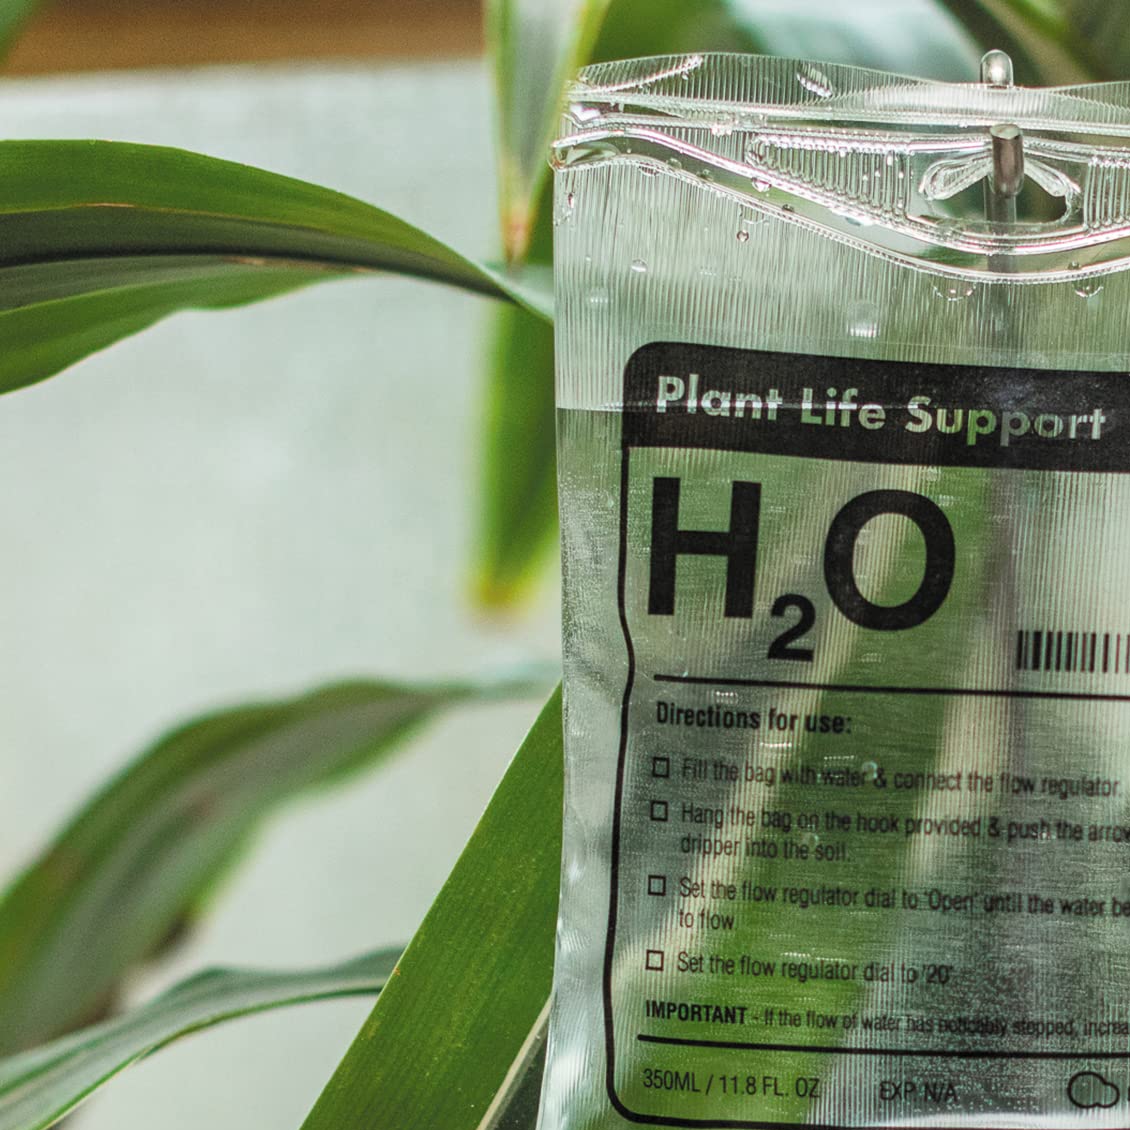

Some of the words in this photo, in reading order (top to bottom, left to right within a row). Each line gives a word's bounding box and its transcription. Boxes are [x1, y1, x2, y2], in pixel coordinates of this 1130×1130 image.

[656, 374, 783, 421] Plant
[801, 387, 886, 430] Life
[905, 397, 1106, 446] Support
[647, 477, 956, 662] H2O
[657, 701, 760, 730] Directions
[769, 708, 798, 731] for
[805, 714, 852, 734] use:
[683, 758, 708, 778] Fill
[713, 761, 738, 781] the
[745, 761, 775, 787] bag
[782, 767, 816, 785] with
[823, 769, 867, 787] water
[873, 769, 887, 788] &
[894, 770, 962, 792] connect
[968, 773, 993, 793] the
[1001, 774, 1035, 793] flow
[682, 803, 723, 828] Hang
[730, 807, 755, 826] the
[762, 809, 791, 832] bag
[800, 816, 819, 831] on
[825, 811, 850, 831] the
[857, 813, 899, 833] hook
[905, 816, 981, 838] provided
[988, 816, 1000, 837] &
[1008, 820, 1050, 842] push
[1056, 821, 1083, 841] the
[681, 833, 740, 859] dripper
[746, 838, 778, 858] into
[783, 841, 808, 860] the
[679, 876, 706, 898] Set
[711, 880, 736, 900] the
[742, 881, 776, 902] flow
[783, 886, 859, 908] regulator
[864, 889, 895, 909] dial
[902, 890, 918, 910] to
[983, 893, 1022, 914] until
[1027, 894, 1054, 915] the
[1059, 898, 1106, 917] water
[679, 909, 694, 928] to
[677, 951, 703, 973] Set
[710, 954, 735, 974] the
[740, 955, 775, 976] flow
[782, 961, 857, 983] regulator
[864, 960, 895, 982] dial
[902, 961, 918, 983] to
[646, 1000, 748, 1025] IMPORTANT
[764, 1009, 774, 1026] If
[779, 1010, 801, 1028] the
[806, 1011, 837, 1029] flow
[843, 1012, 857, 1030] of
[862, 1014, 900, 1032] water
[908, 1015, 933, 1033] has
[643, 1068, 700, 1094] 350ML
[705, 1072, 713, 1095] /
[719, 1075, 757, 1096] 11.8
[763, 1076, 788, 1097] FL.
[795, 1078, 822, 1099] OZ
[880, 1080, 917, 1101] EXP
[924, 1082, 958, 1101] N/A
